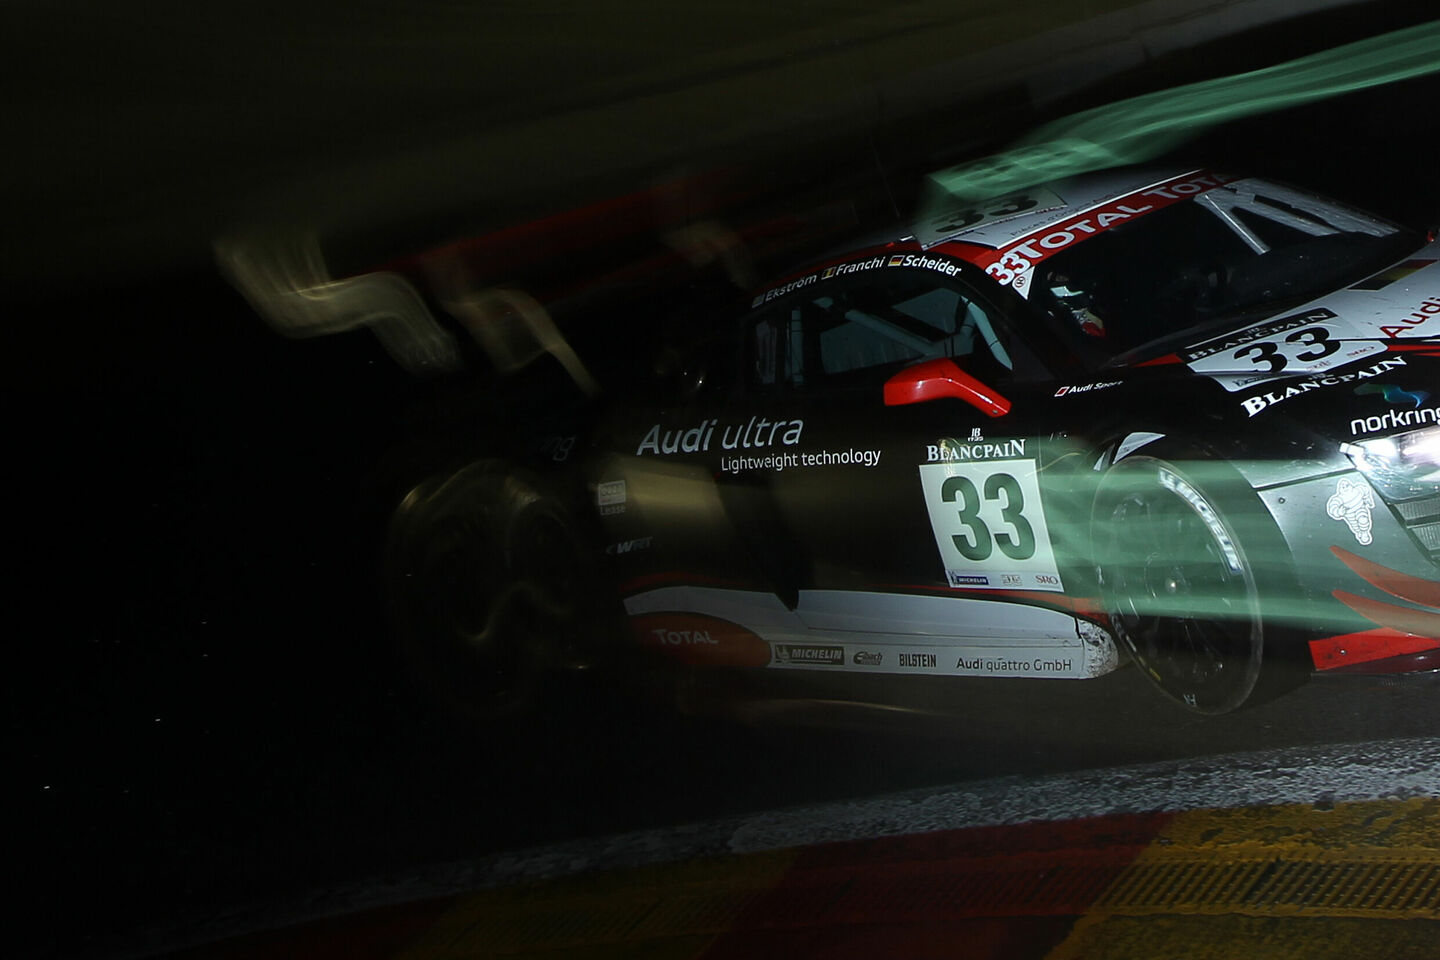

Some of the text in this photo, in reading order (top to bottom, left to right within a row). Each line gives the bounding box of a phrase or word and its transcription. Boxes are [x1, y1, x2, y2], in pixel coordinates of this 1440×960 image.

[985, 250, 1031, 286] 33
[1012, 202, 1153, 260] TOTAL
[835, 254, 885, 277] Franchi
[902, 254, 962, 278] Scheider
[1188, 312, 1328, 360] BLANCPAIN
[1234, 327, 1341, 373] 33
[1068, 383, 1094, 394] Audi
[1240, 355, 1408, 418] BLANCPAIN
[636, 414, 805, 457] Audi ultra
[721, 448, 882, 475] Lightweight technology
[926, 438, 1026, 462] BLANCPAIN
[941, 473, 1036, 562] 33
[1036, 575, 1059, 585] SRO
[651, 628, 719, 645] TOTAL
[791, 648, 842, 661] MICHELIN
[899, 653, 937, 667] BILSTEIN
[956, 658, 1072, 672] Audi quattro GmbH
